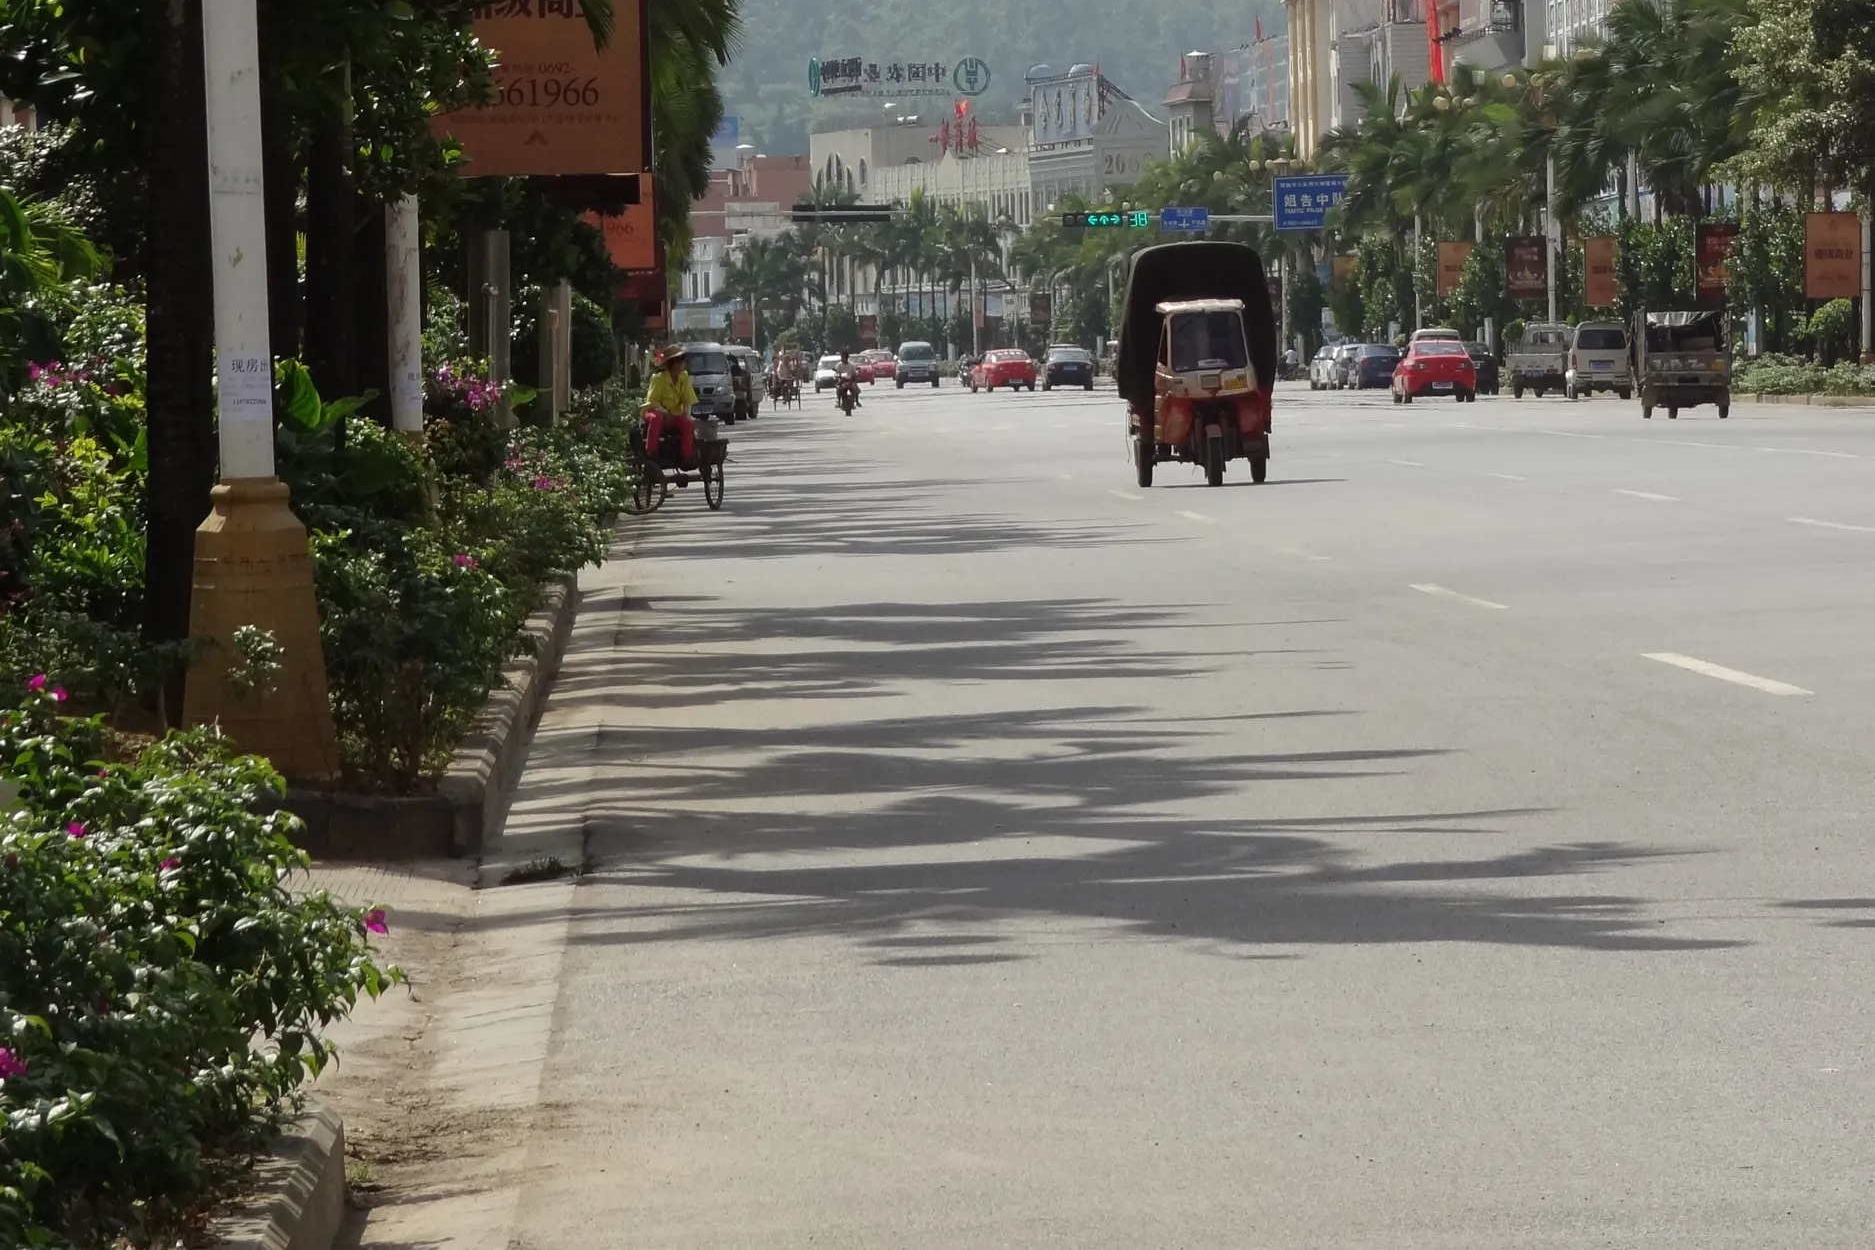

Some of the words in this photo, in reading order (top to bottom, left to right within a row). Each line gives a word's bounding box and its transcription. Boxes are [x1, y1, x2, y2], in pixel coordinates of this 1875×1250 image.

[538, 62, 576, 75] 0692-
[1283, 191, 1345, 208] 姐告中队
[1129, 212, 1148, 227] 38
